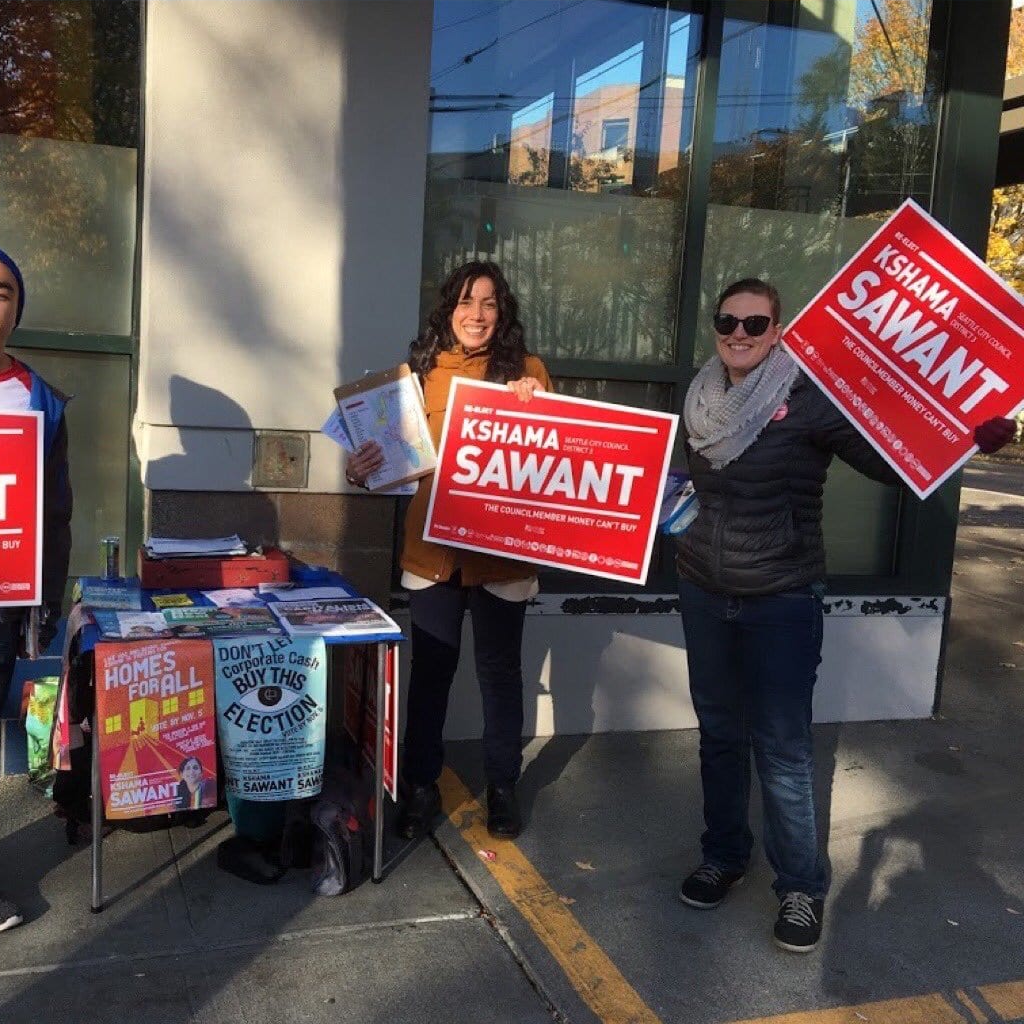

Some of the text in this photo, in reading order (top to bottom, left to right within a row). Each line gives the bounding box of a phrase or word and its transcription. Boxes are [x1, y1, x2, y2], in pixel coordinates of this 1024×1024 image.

[873, 244, 959, 320] KSHAMA
[837, 270, 1009, 414] SAWANT
[950, 320, 973, 339] DISTRICT
[957, 312, 1012, 359] SEATTLE CITY COUNCIL
[842, 336, 856, 350] THE
[852, 346, 905, 395] COUNCILMEMBER
[903, 391, 926, 414] MONEY
[924, 410, 946, 432] CAN'T
[942, 428, 959, 444] BUY
[461, 418, 560, 450] KSHAMA
[565, 436, 630, 450] SEATTLE CITY COUNCIL
[452, 445, 644, 506] SAWANT
[484, 503, 637, 532] THE COUNCILMEMBER MONEY CAN'T BUY
[2, 540, 20, 549] BUY
[219, 635, 293, 662] DON'T LET
[106, 651, 176, 690] HOMES
[222, 652, 320, 679] Corporate Cash
[129, 667, 203, 700] FOR ALL
[232, 667, 306, 694] BUY THIS
[224, 694, 317, 734] ELECTION
[110, 782, 180, 806] SAWANT
[243, 778, 294, 792] SAWANT
[298, 776, 323, 789] SAW
